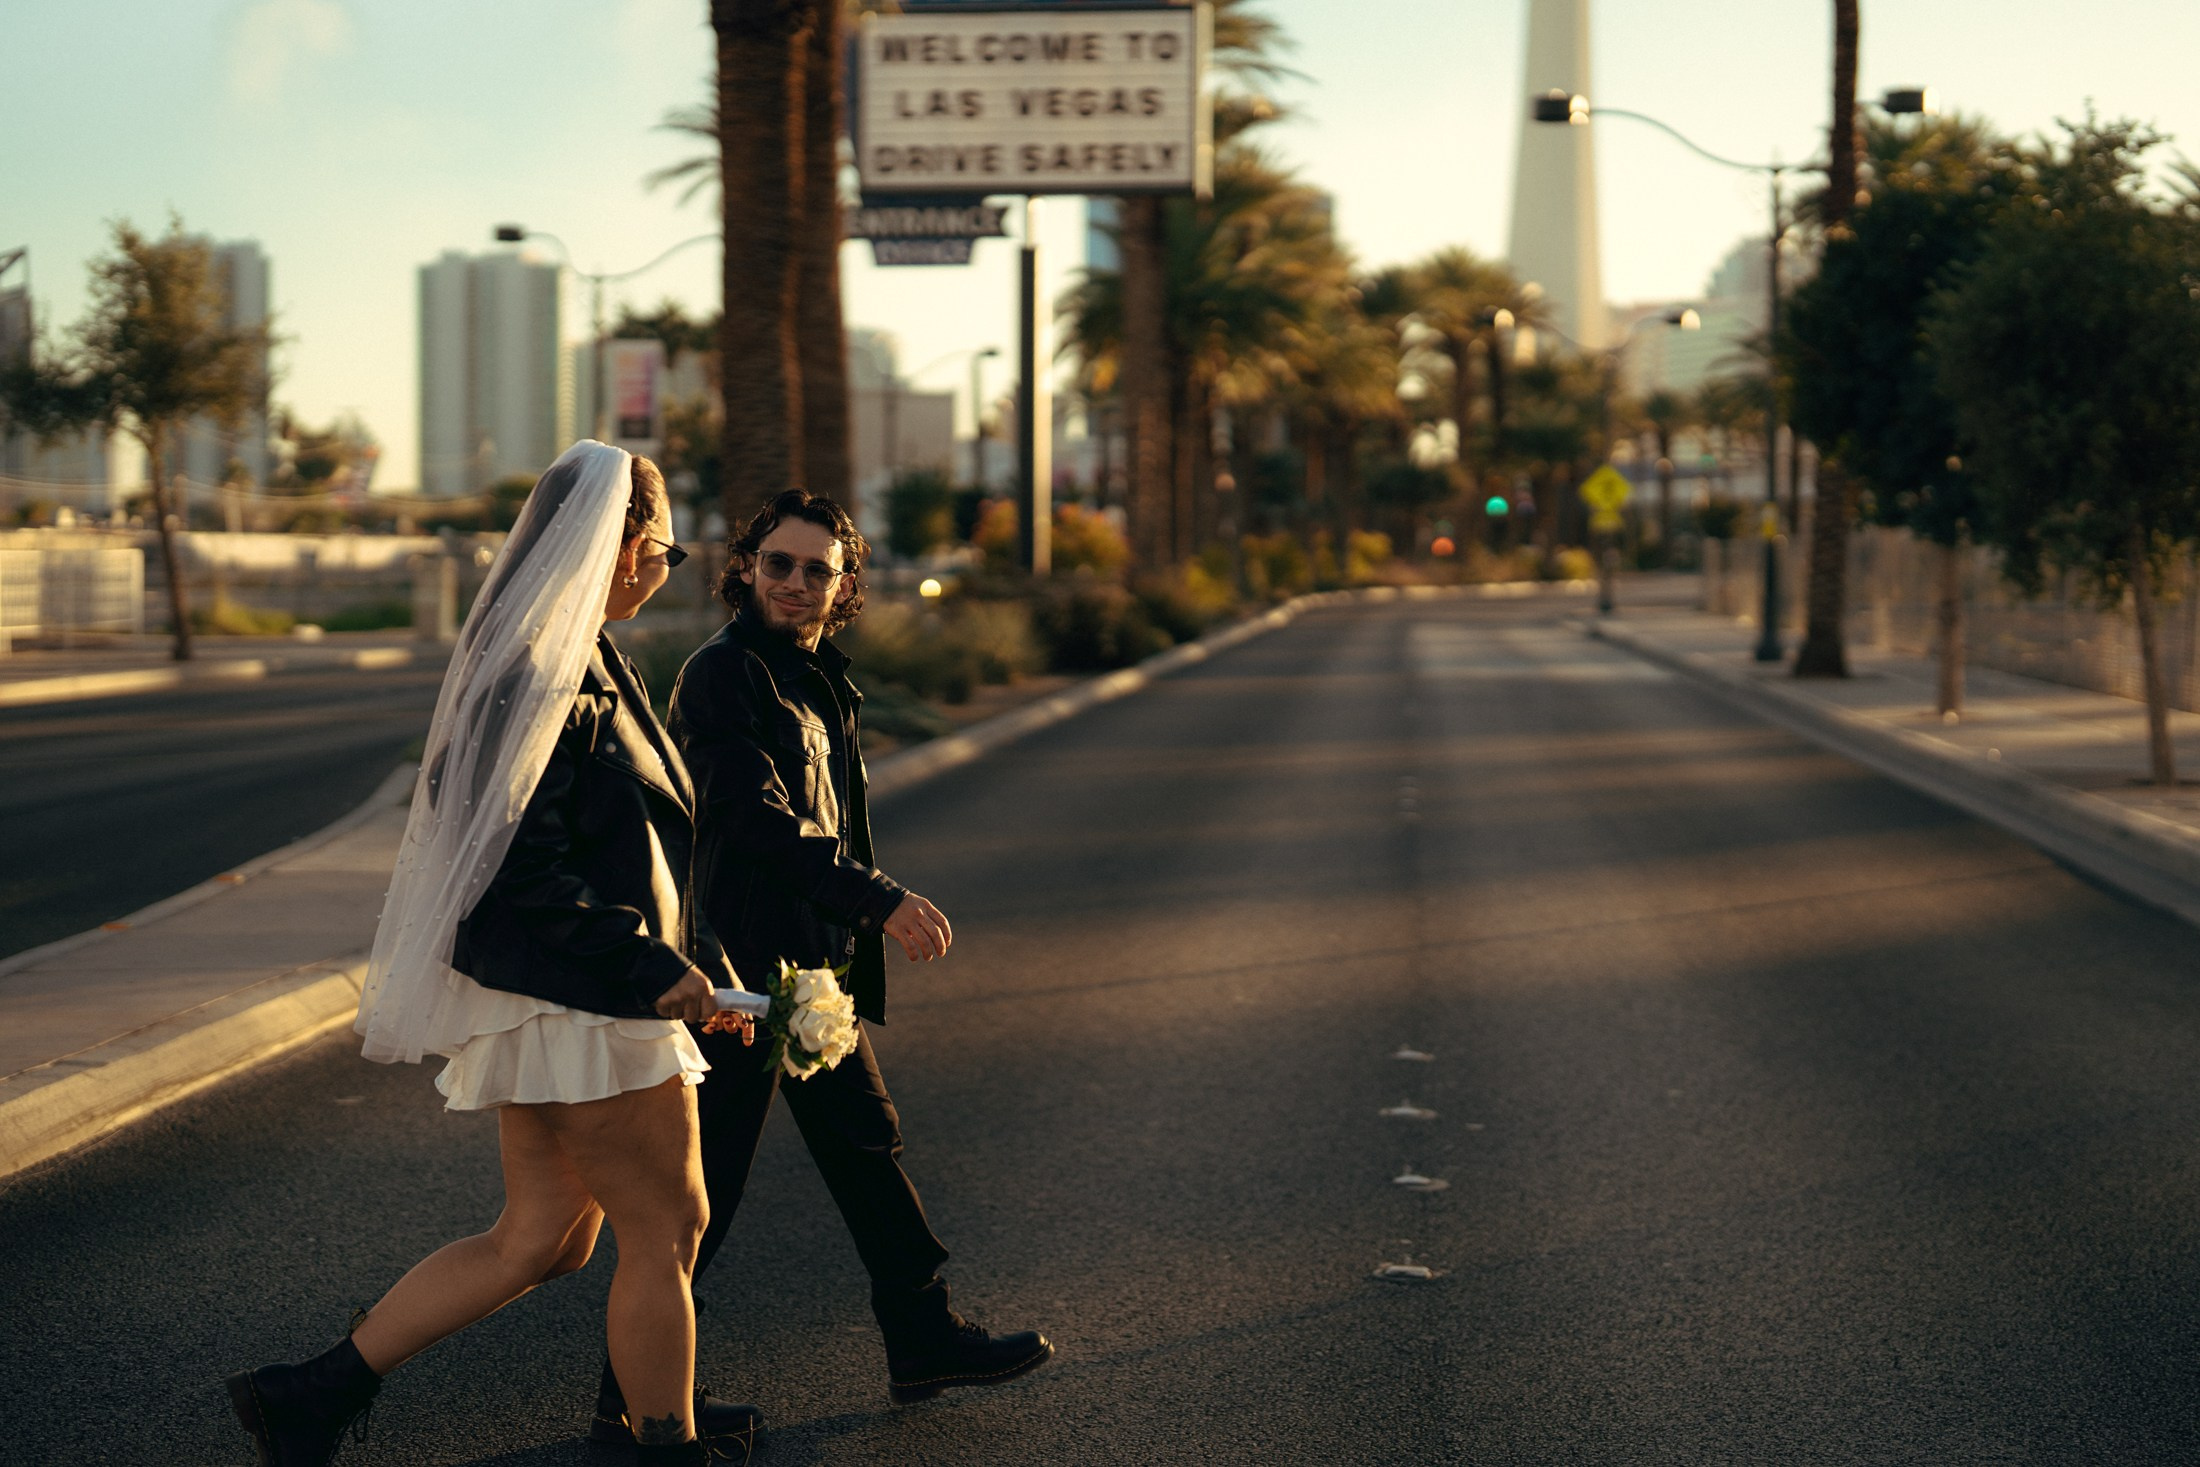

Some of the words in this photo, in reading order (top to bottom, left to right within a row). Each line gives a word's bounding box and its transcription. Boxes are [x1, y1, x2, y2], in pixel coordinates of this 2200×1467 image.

[1123, 32, 1181, 61] TO
[895, 88, 981, 118] LAS
[1011, 87, 1163, 117] VEGAS
[873, 145, 1000, 173] DRIVE
[1019, 144, 1182, 172] SAFELY
